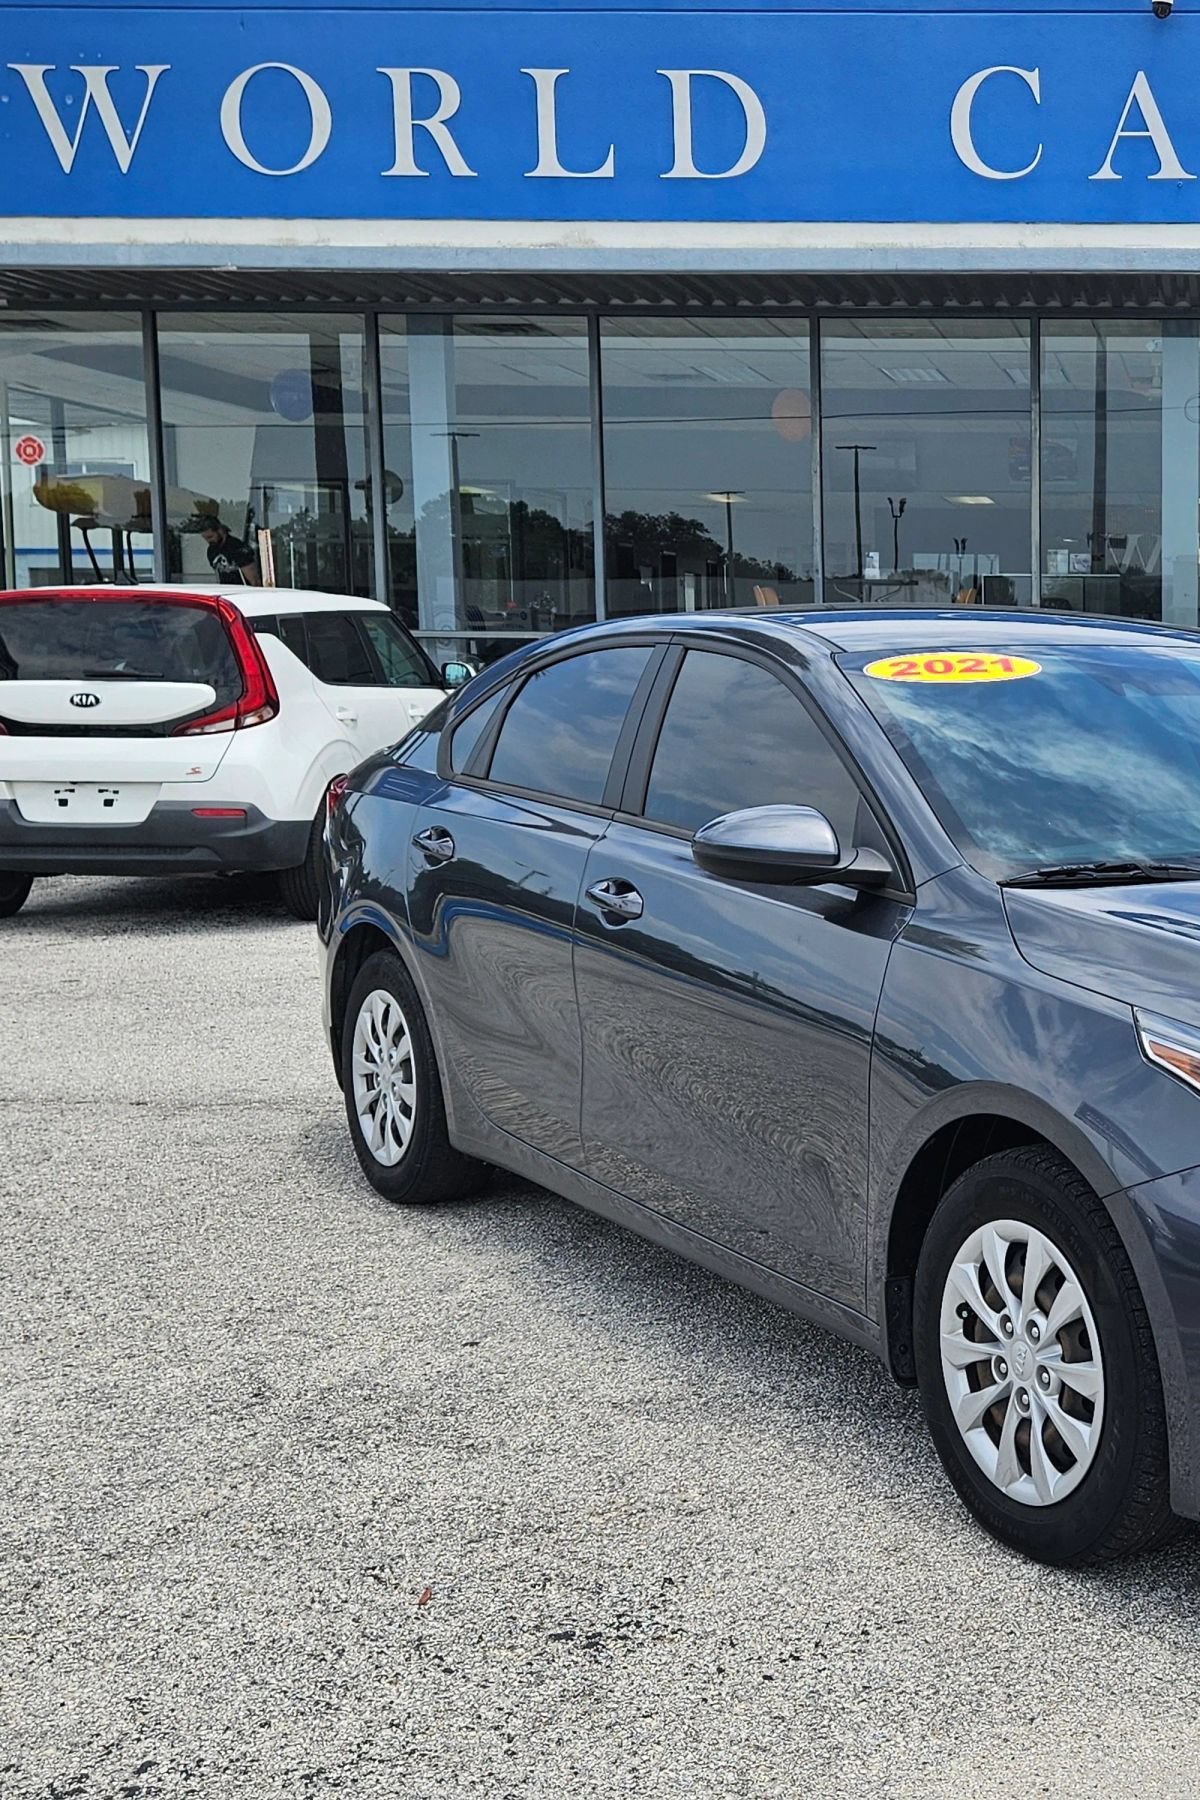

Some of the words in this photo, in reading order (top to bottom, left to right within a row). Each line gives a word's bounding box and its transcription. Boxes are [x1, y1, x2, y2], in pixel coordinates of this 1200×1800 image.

[6, 61, 767, 179] WORLD
[888, 657, 1015, 677] 2021
[72, 694, 97, 706] KIA
